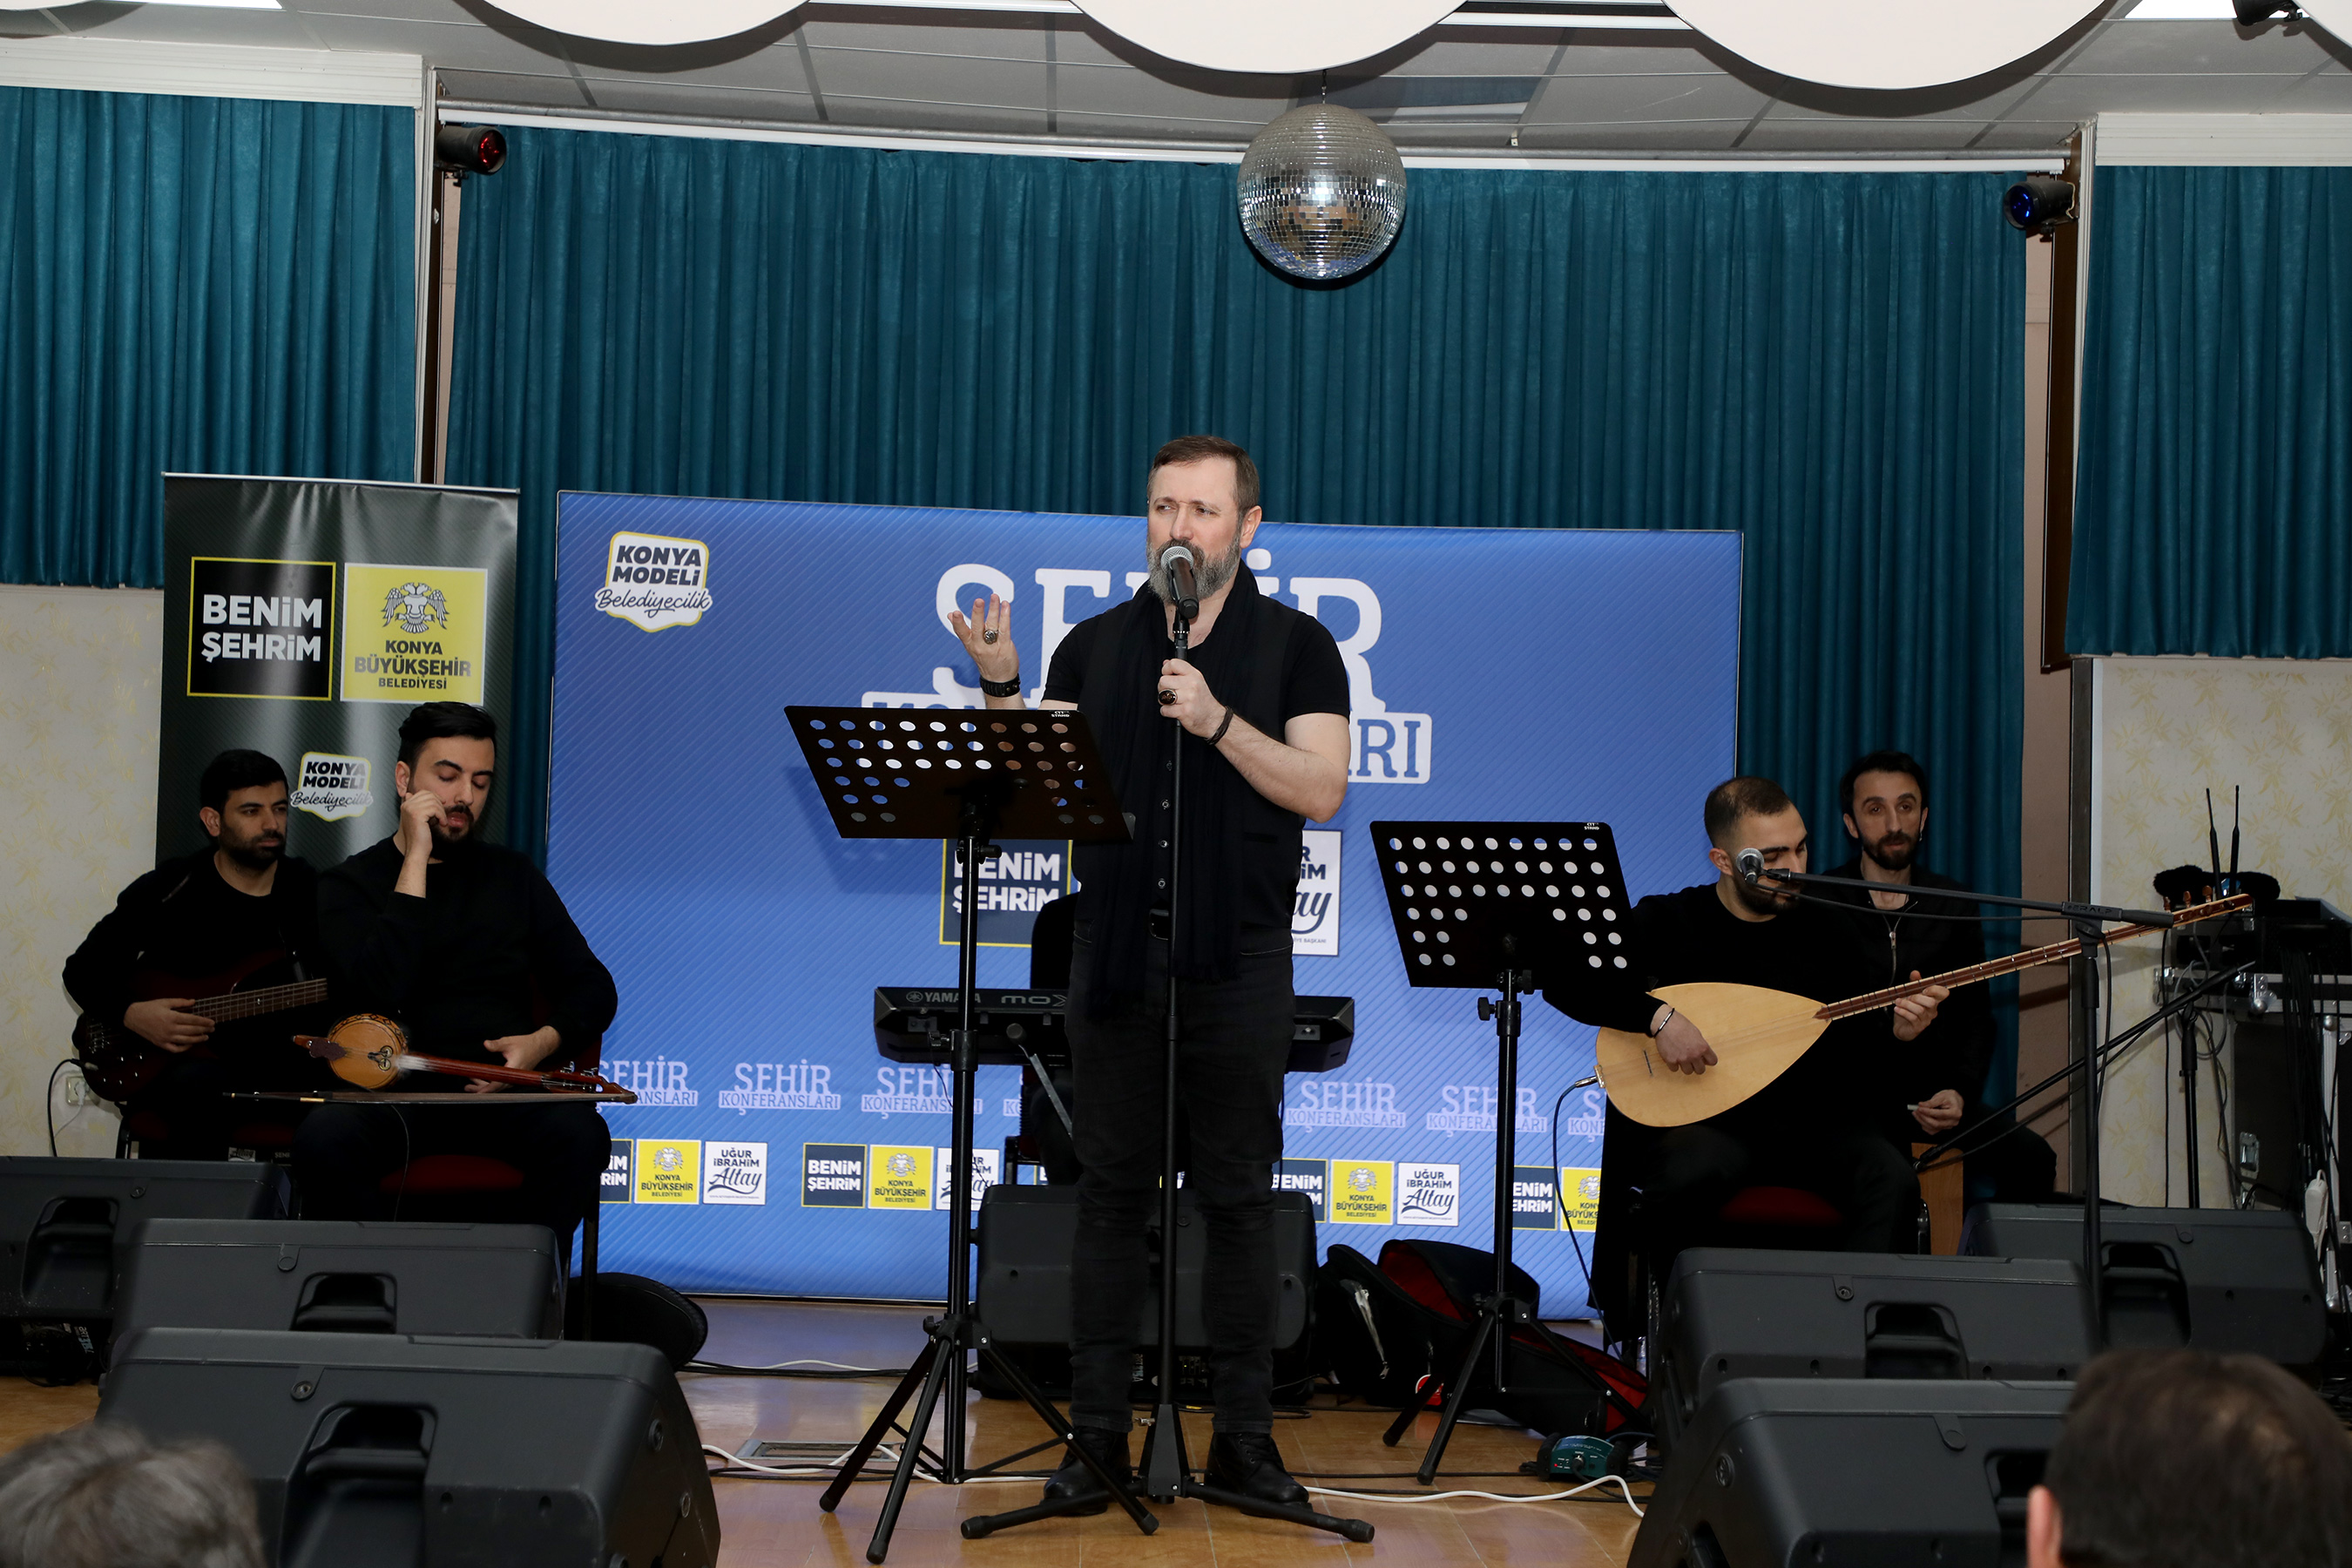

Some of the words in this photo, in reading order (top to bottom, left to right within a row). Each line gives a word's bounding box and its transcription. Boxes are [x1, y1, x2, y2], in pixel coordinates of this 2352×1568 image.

[616, 544, 701, 567] KONYA
[597, 588, 711, 618] Belediyecilik
[385, 639, 443, 655] KONYA
[354, 652, 472, 679] BÜYÜKŞEHİR
[378, 677, 448, 690] BELEDİYESİ
[305, 761, 366, 776] KONYA
[291, 791, 371, 812] Belediyecilik
[924, 991, 982, 1004] YAMAA
[720, 1092, 841, 1111] KONFERANSLARI
[1288, 1110, 1404, 1127] KONFERANSLARI
[721, 1147, 752, 1158] UĞUR
[707, 1167, 762, 1194] Altay
[1414, 1169, 1444, 1179] UĞUR
[641, 1180, 693, 1192] BÜYÜKŞEHİR
[875, 1186, 927, 1198] BÜYÜKŞEHİR
[1335, 1201, 1388, 1213] BÜYÜKŞEHİR
[1401, 1188, 1456, 1216] Altay
